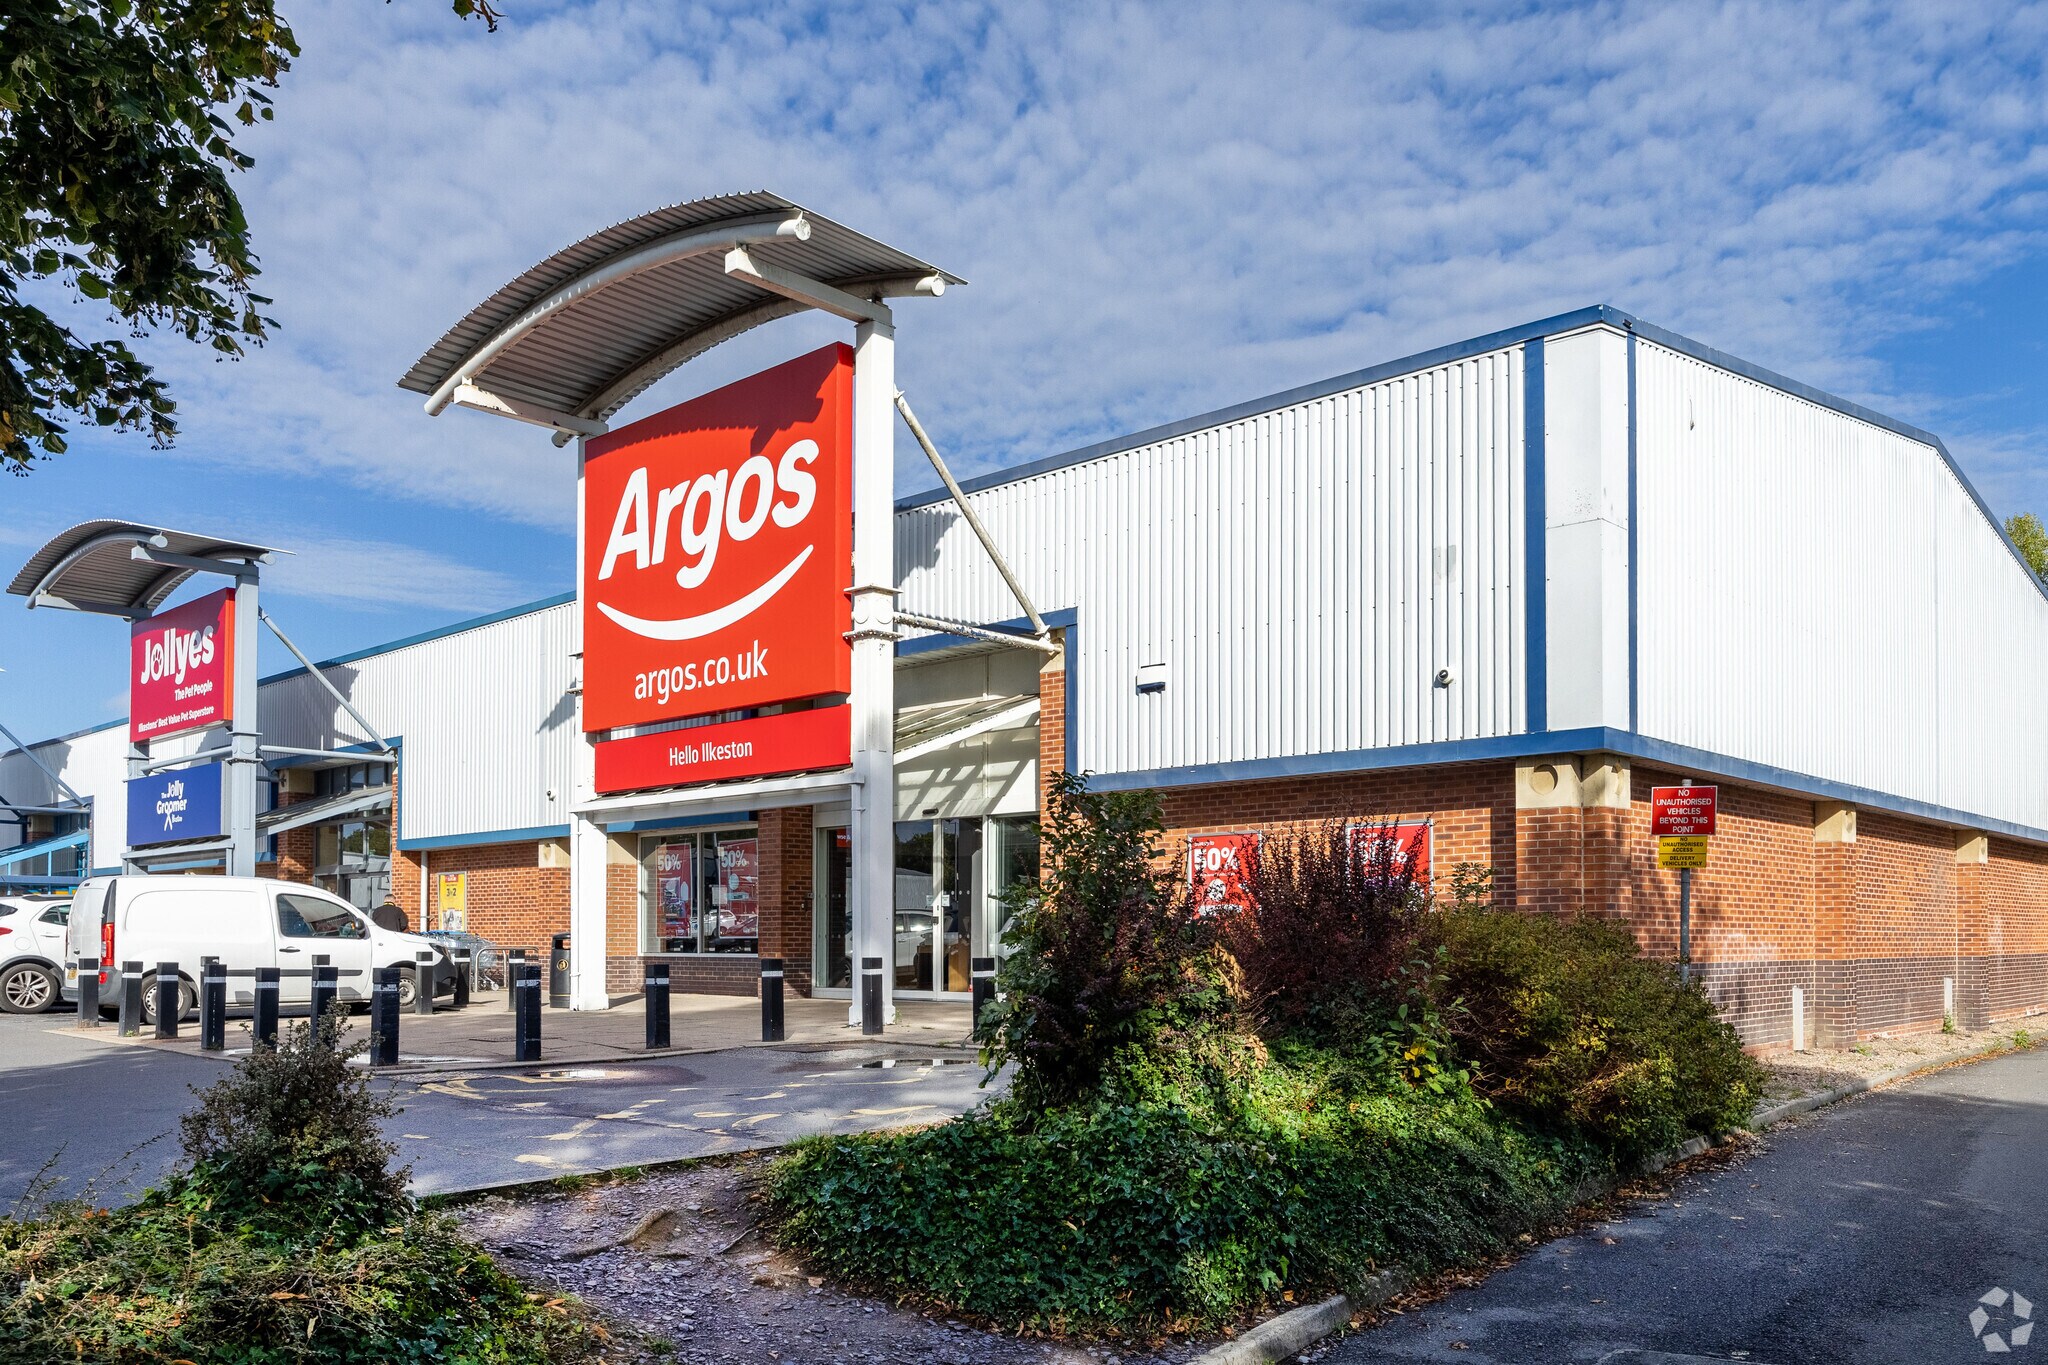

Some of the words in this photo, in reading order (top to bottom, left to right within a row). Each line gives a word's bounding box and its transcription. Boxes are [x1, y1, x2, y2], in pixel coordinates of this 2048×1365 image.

[597, 438, 820, 589] Argos
[140, 625, 214, 685] Jollyes
[634, 639, 769, 705] argos.co.uk
[175, 688, 185, 701] The
[184, 685, 194, 698] Pet
[193, 679, 213, 696] People
[158, 716, 169, 728] Best
[168, 713, 181, 725] Value
[180, 710, 189, 722] Pet
[189, 705, 215, 720] Superstore
[668, 746, 699, 767] Hello
[701, 741, 753, 764] Ilkeston
[167, 779, 185, 800] Jolly
[1678, 789, 1690, 797] NO
[156, 799, 188, 815] Groomer
[1656, 798, 1711, 806] UNAUTHORISED
[1672, 825, 1695, 833] POINT
[1692, 816, 1708, 824] THIS
[657, 853, 682, 871] 50%
[721, 849, 747, 868] 50%
[1194, 847, 1239, 871] 50%
